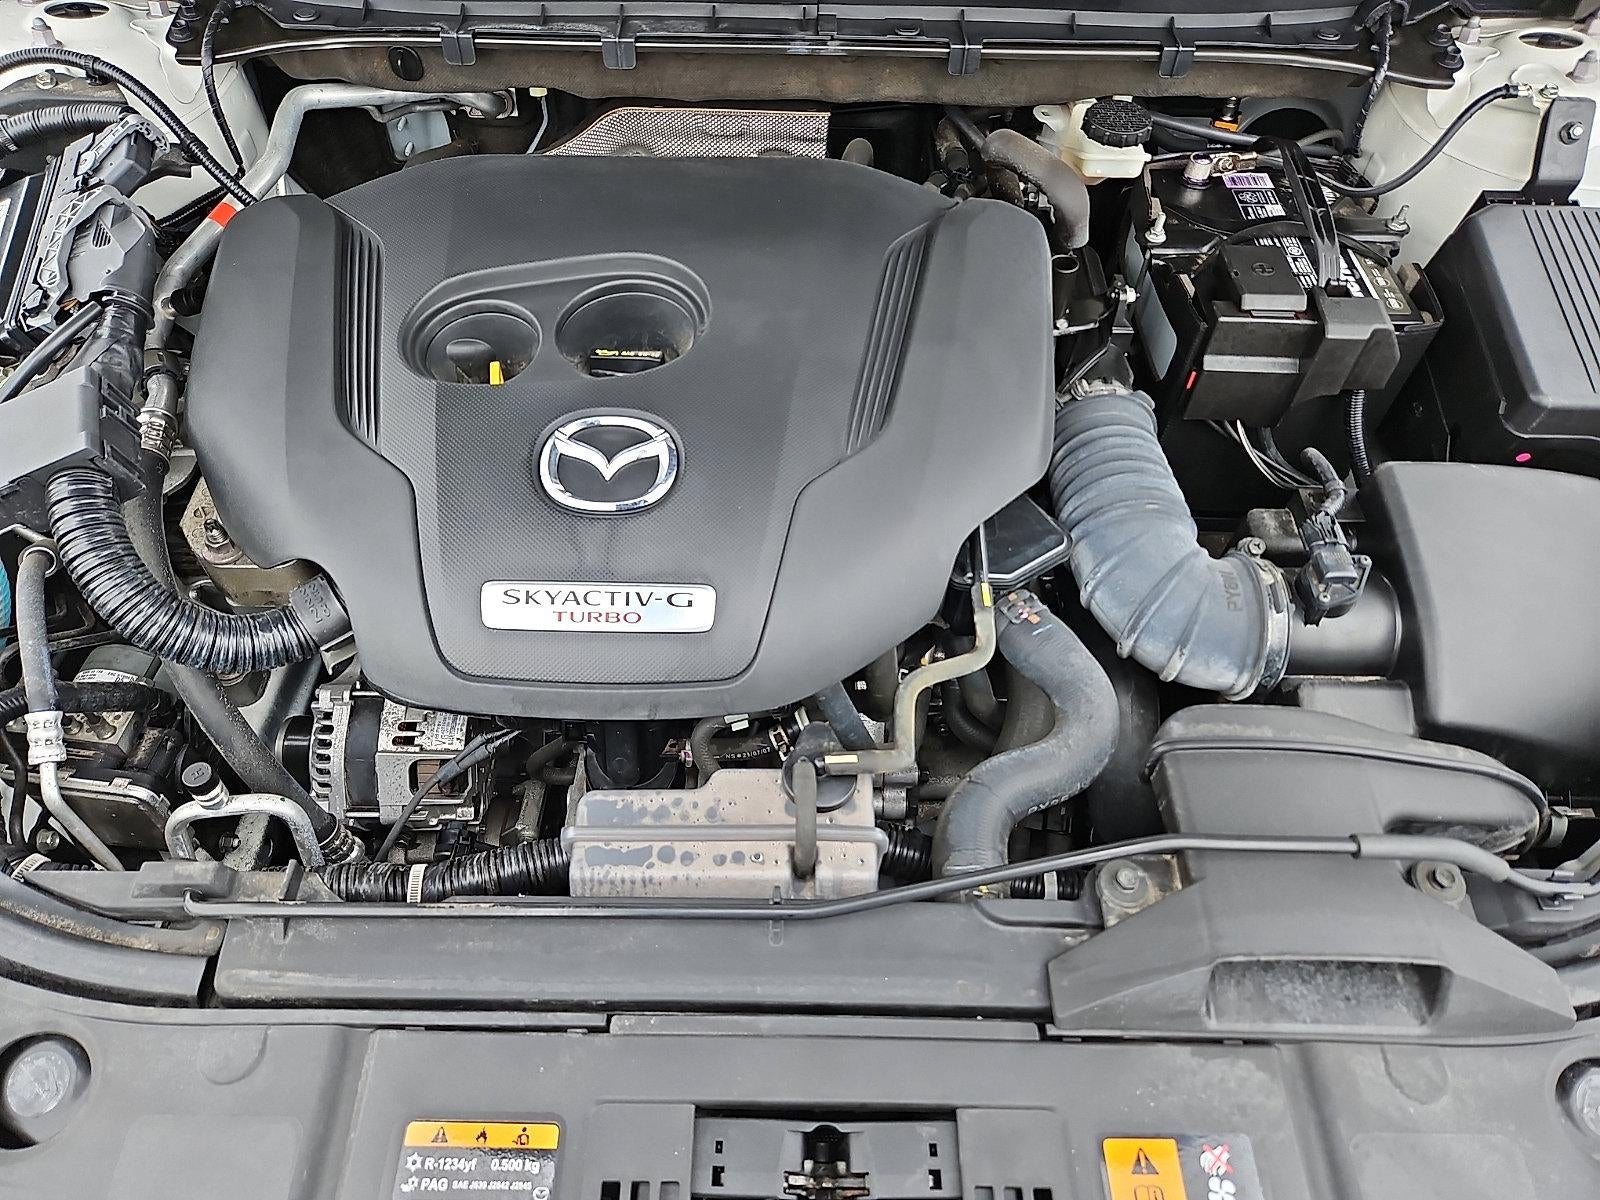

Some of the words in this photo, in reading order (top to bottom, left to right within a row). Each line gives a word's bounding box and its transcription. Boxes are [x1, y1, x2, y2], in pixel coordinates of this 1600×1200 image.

[501, 588, 694, 608] SKYACTIV-G
[552, 610, 642, 624] TURBO
[424, 1156, 478, 1173] R-1234yf
[490, 1157, 523, 1172] 0.500
[524, 1158, 541, 1175] kg
[420, 1177, 449, 1192] PAG
